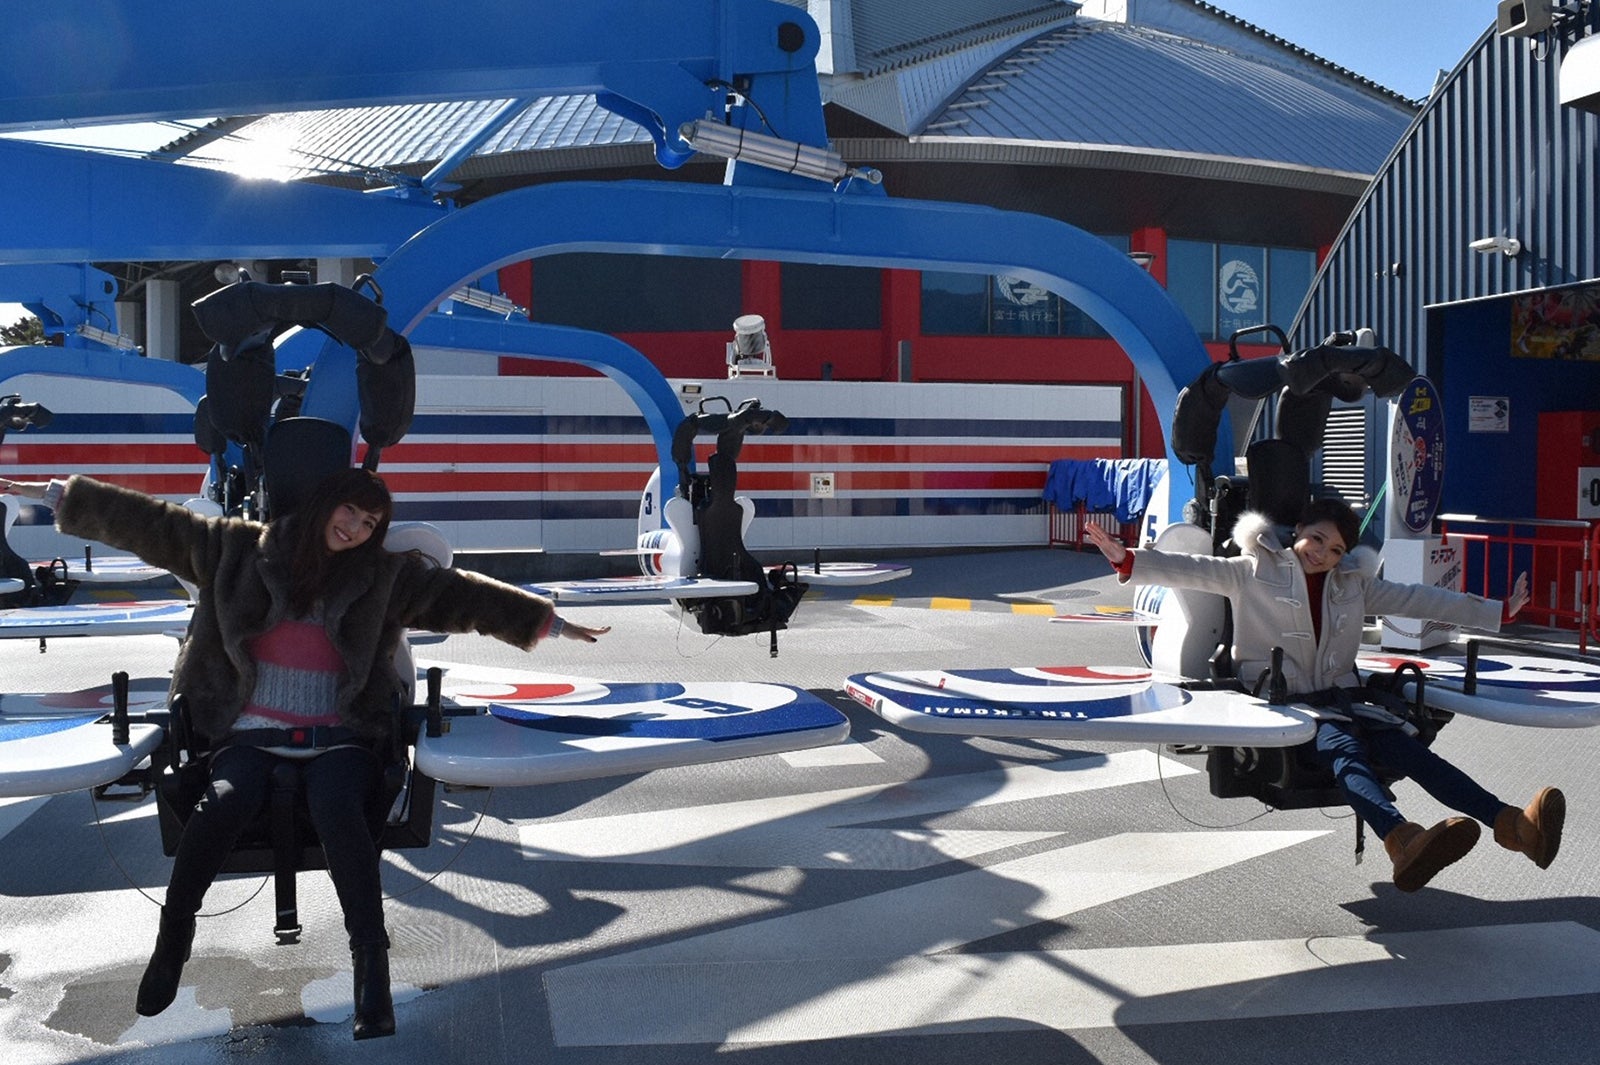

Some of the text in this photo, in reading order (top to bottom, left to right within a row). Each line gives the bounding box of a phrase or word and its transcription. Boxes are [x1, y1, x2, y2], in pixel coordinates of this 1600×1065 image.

[993, 309, 1055, 322] 富士飛行社
[645, 492, 652, 515] 3
[1147, 515, 1157, 537] 5
[924, 706, 1088, 718] TENTEKOMAI
